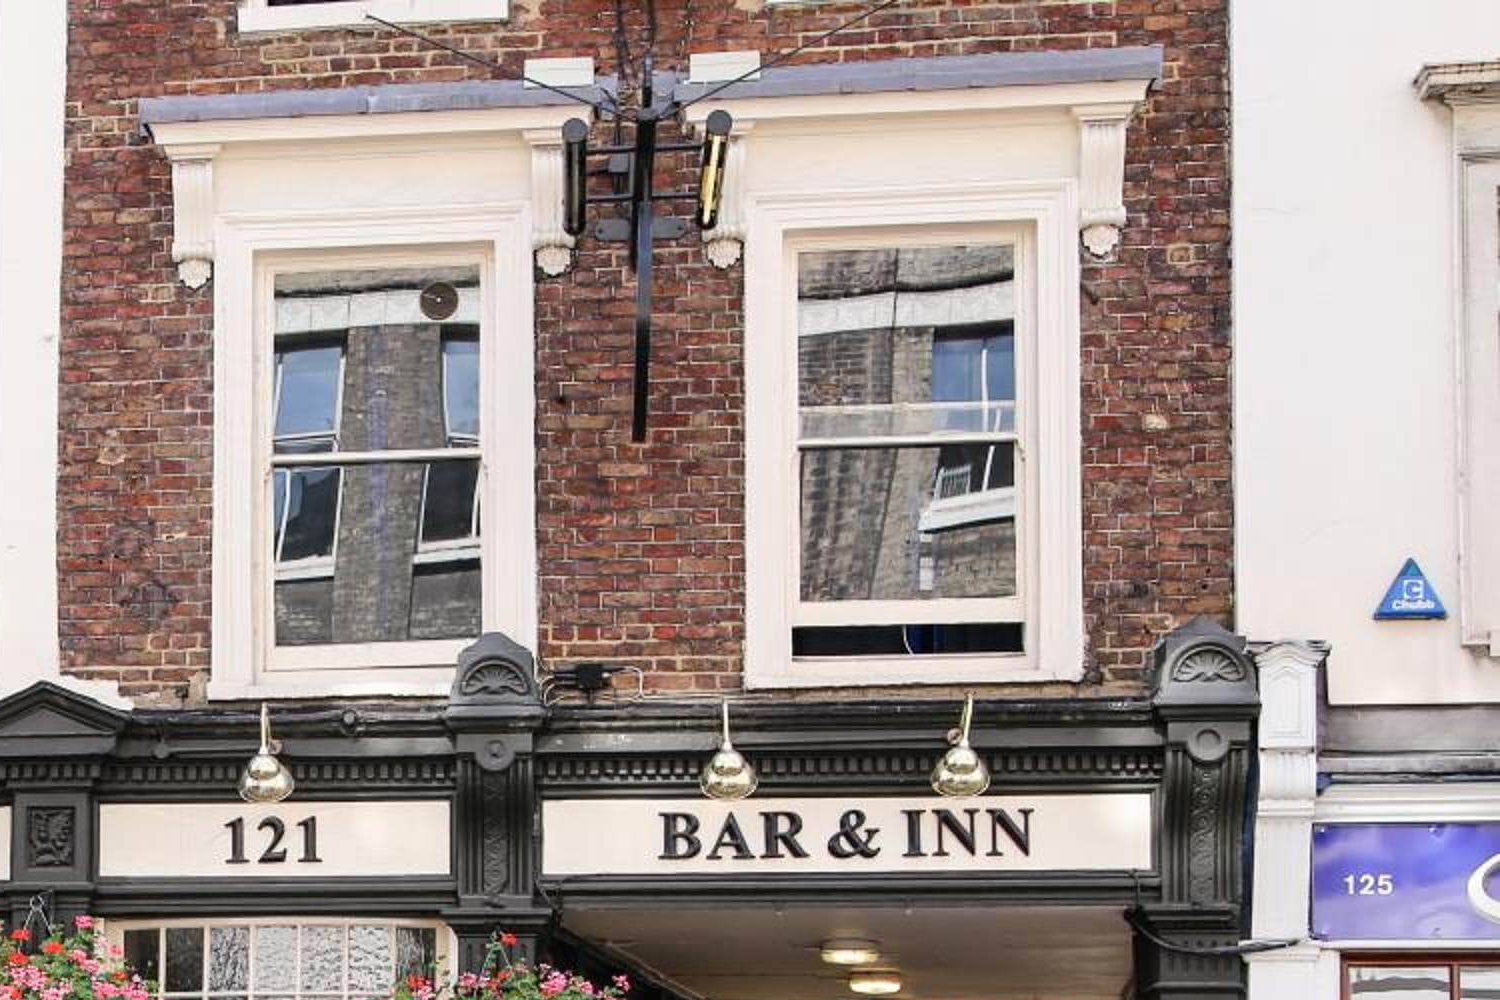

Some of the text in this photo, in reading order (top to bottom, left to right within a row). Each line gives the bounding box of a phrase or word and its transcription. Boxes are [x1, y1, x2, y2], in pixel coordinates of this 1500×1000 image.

[224, 815, 323, 863] 121
[657, 809, 1034, 860] BAR & INN
[1343, 874, 1394, 896] 125
